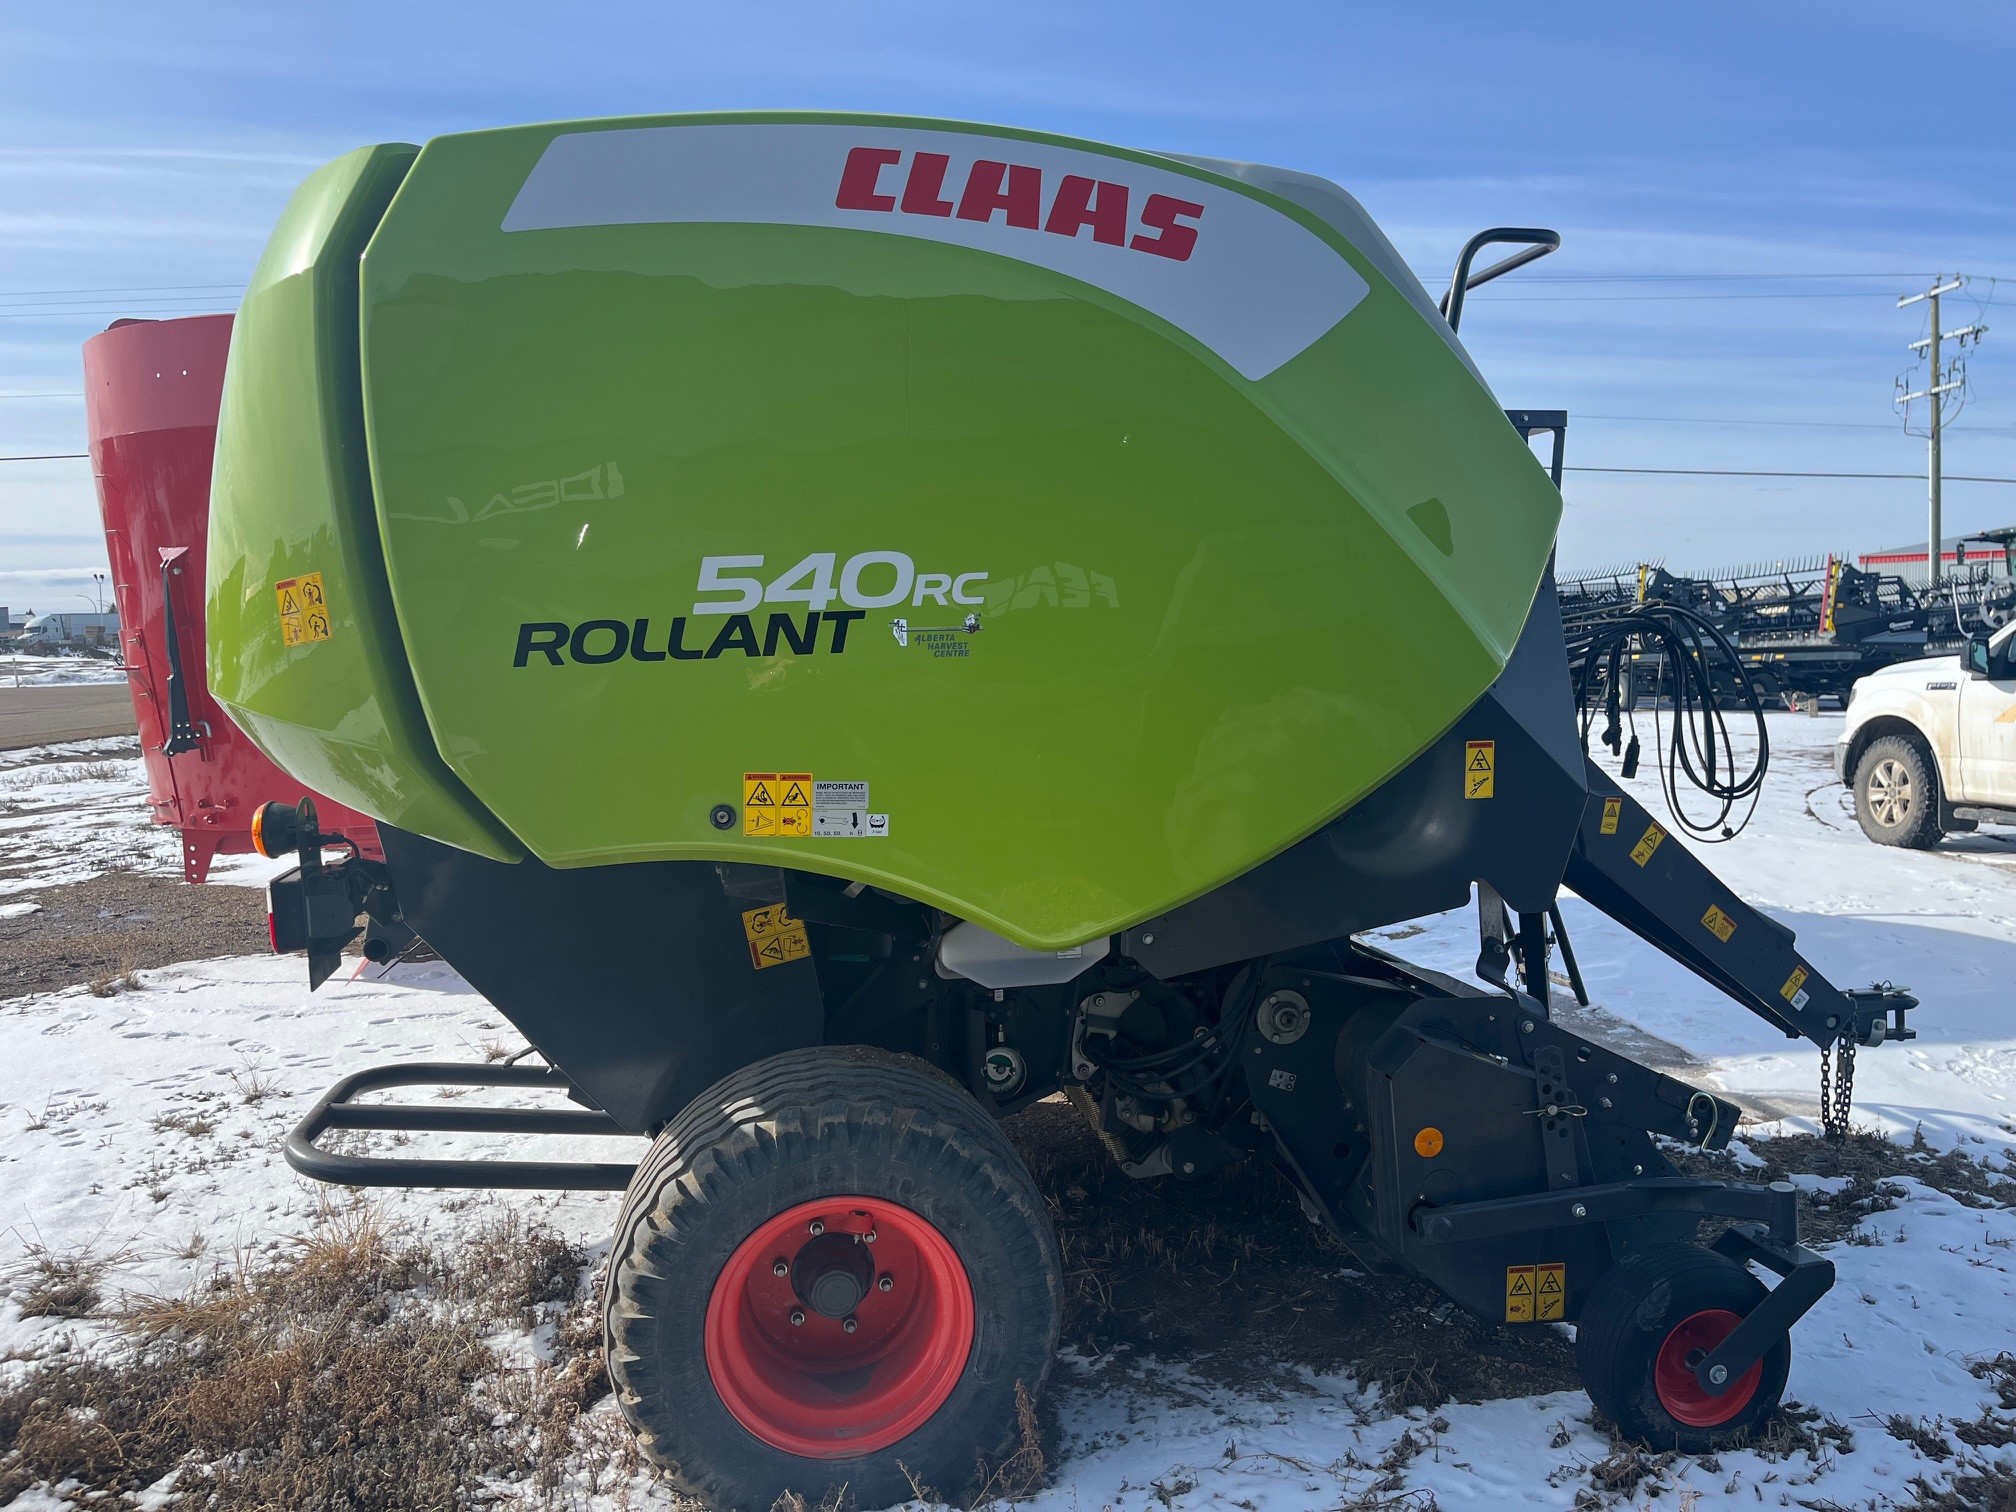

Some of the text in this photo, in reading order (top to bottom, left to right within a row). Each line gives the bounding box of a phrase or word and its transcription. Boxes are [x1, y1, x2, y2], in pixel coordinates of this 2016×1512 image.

[835, 146, 1205, 262] CLAAS
[513, 609, 866, 668] ROLLANT
[915, 634, 956, 646] ALBERTA
[927, 642, 969, 650] HARVEST
[933, 650, 970, 658] CENTRE
